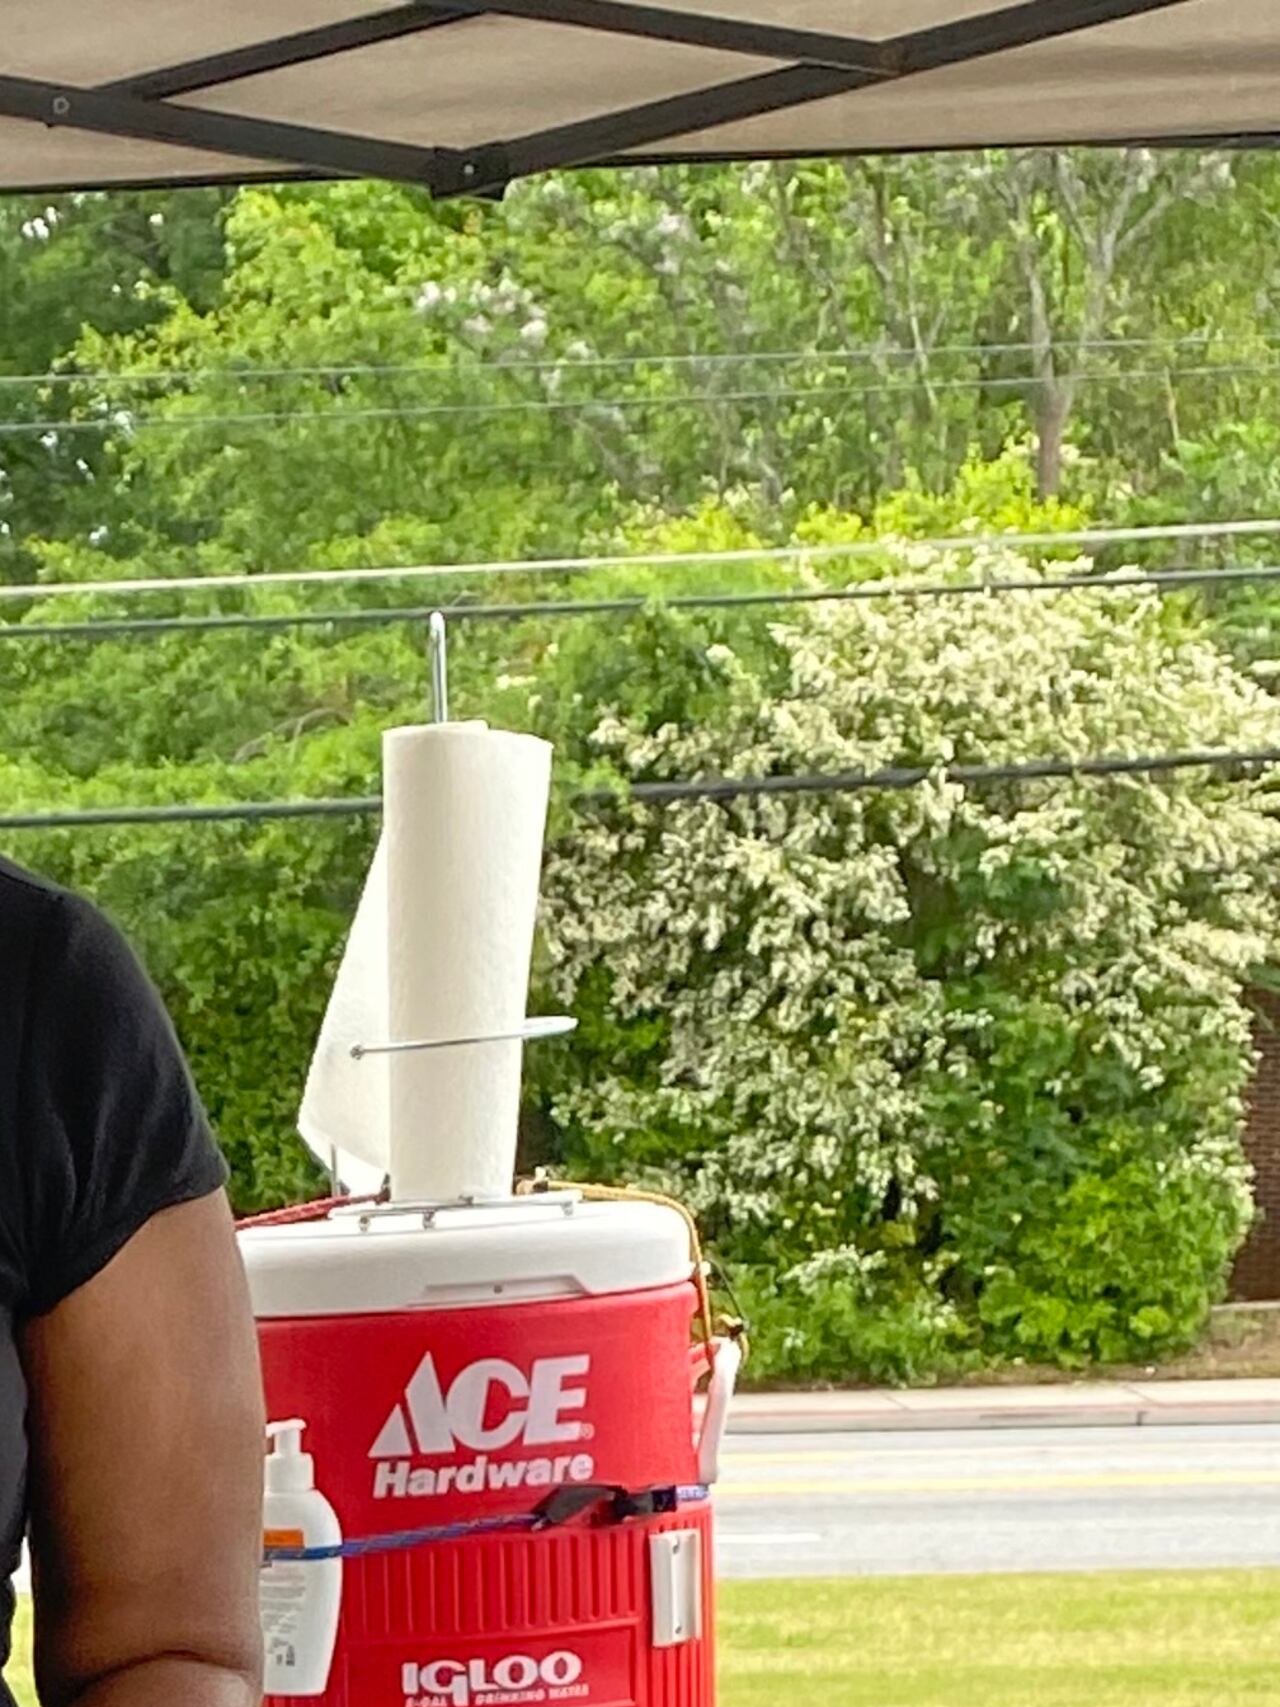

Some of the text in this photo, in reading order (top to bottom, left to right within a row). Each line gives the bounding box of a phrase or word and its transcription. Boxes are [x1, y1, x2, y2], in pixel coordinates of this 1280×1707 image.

[368, 1350, 590, 1458] ACE
[372, 1454, 594, 1499] Hardware
[401, 1650, 582, 1707] IGLOO
